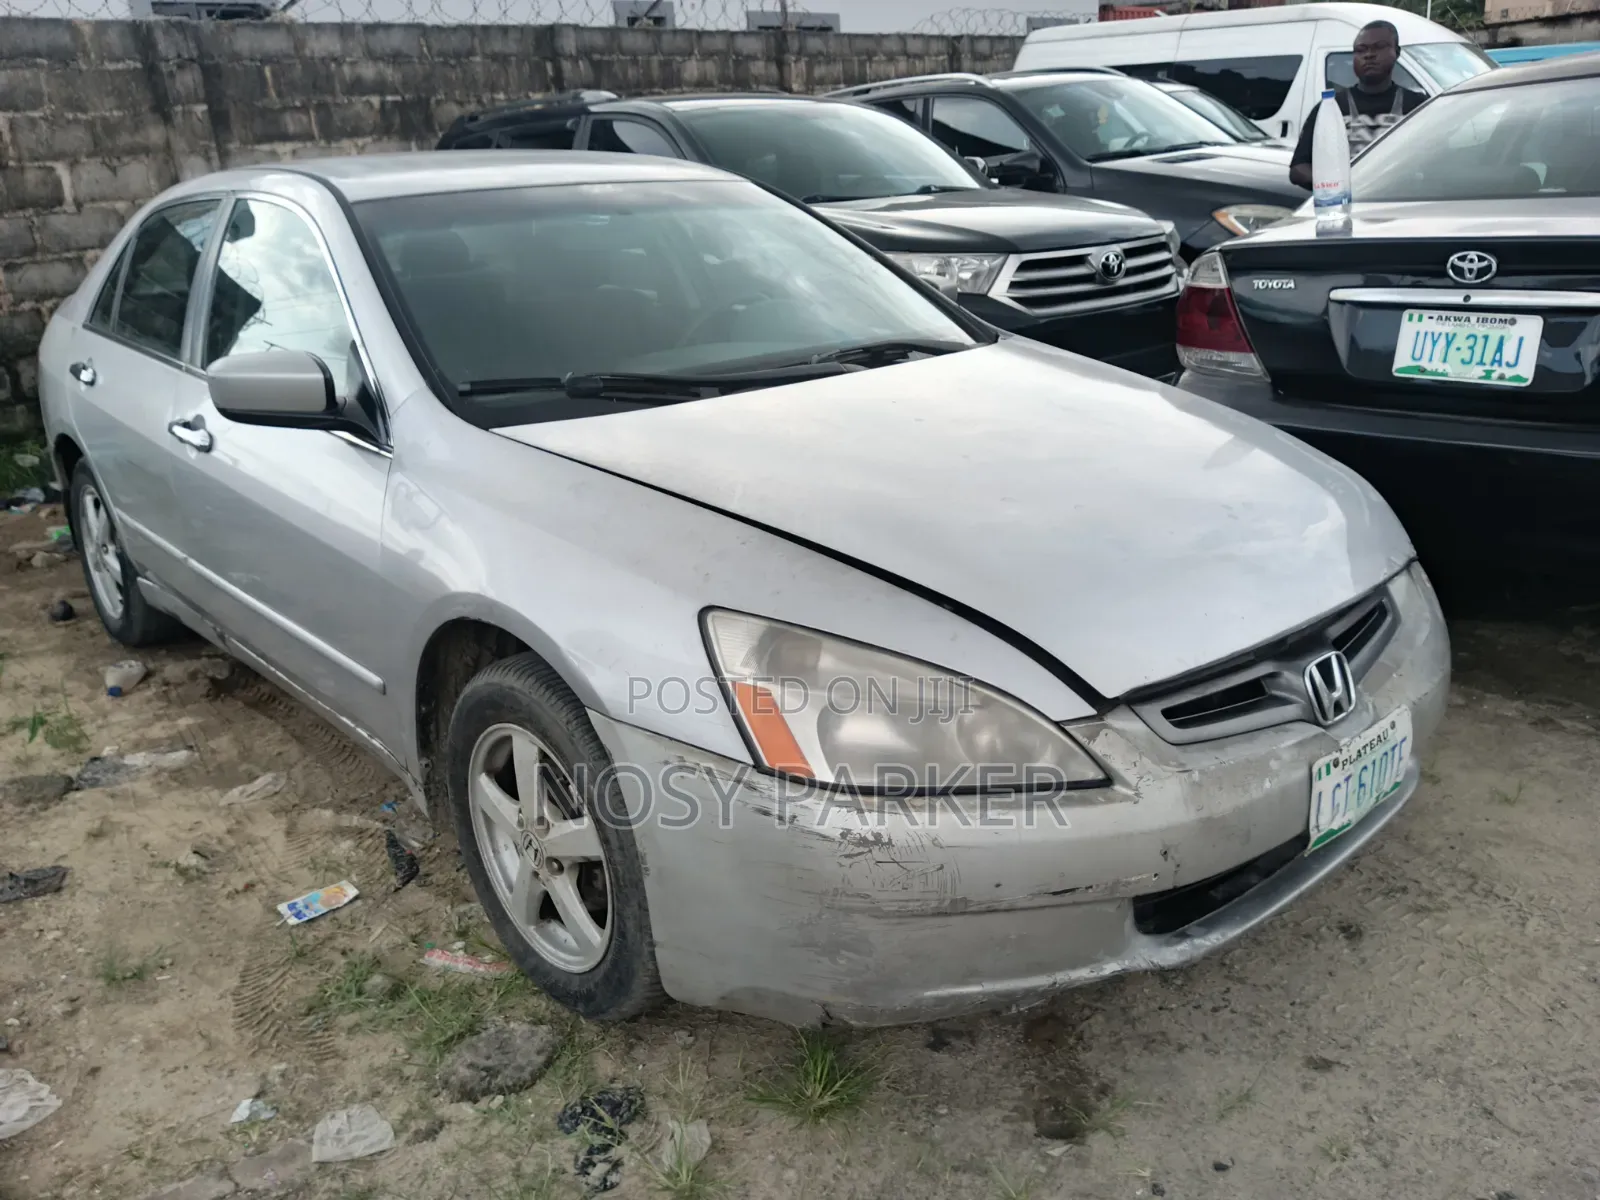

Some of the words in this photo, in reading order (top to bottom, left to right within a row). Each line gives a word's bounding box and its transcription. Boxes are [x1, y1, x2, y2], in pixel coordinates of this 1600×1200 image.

[1252, 279, 1295, 290] TOYOTA
[1436, 315, 1471, 323] AKWA
[1476, 315, 1508, 325] IBOM
[1411, 330, 1525, 368] UYY-31AJ
[1341, 728, 1390, 771] PLATEAU
